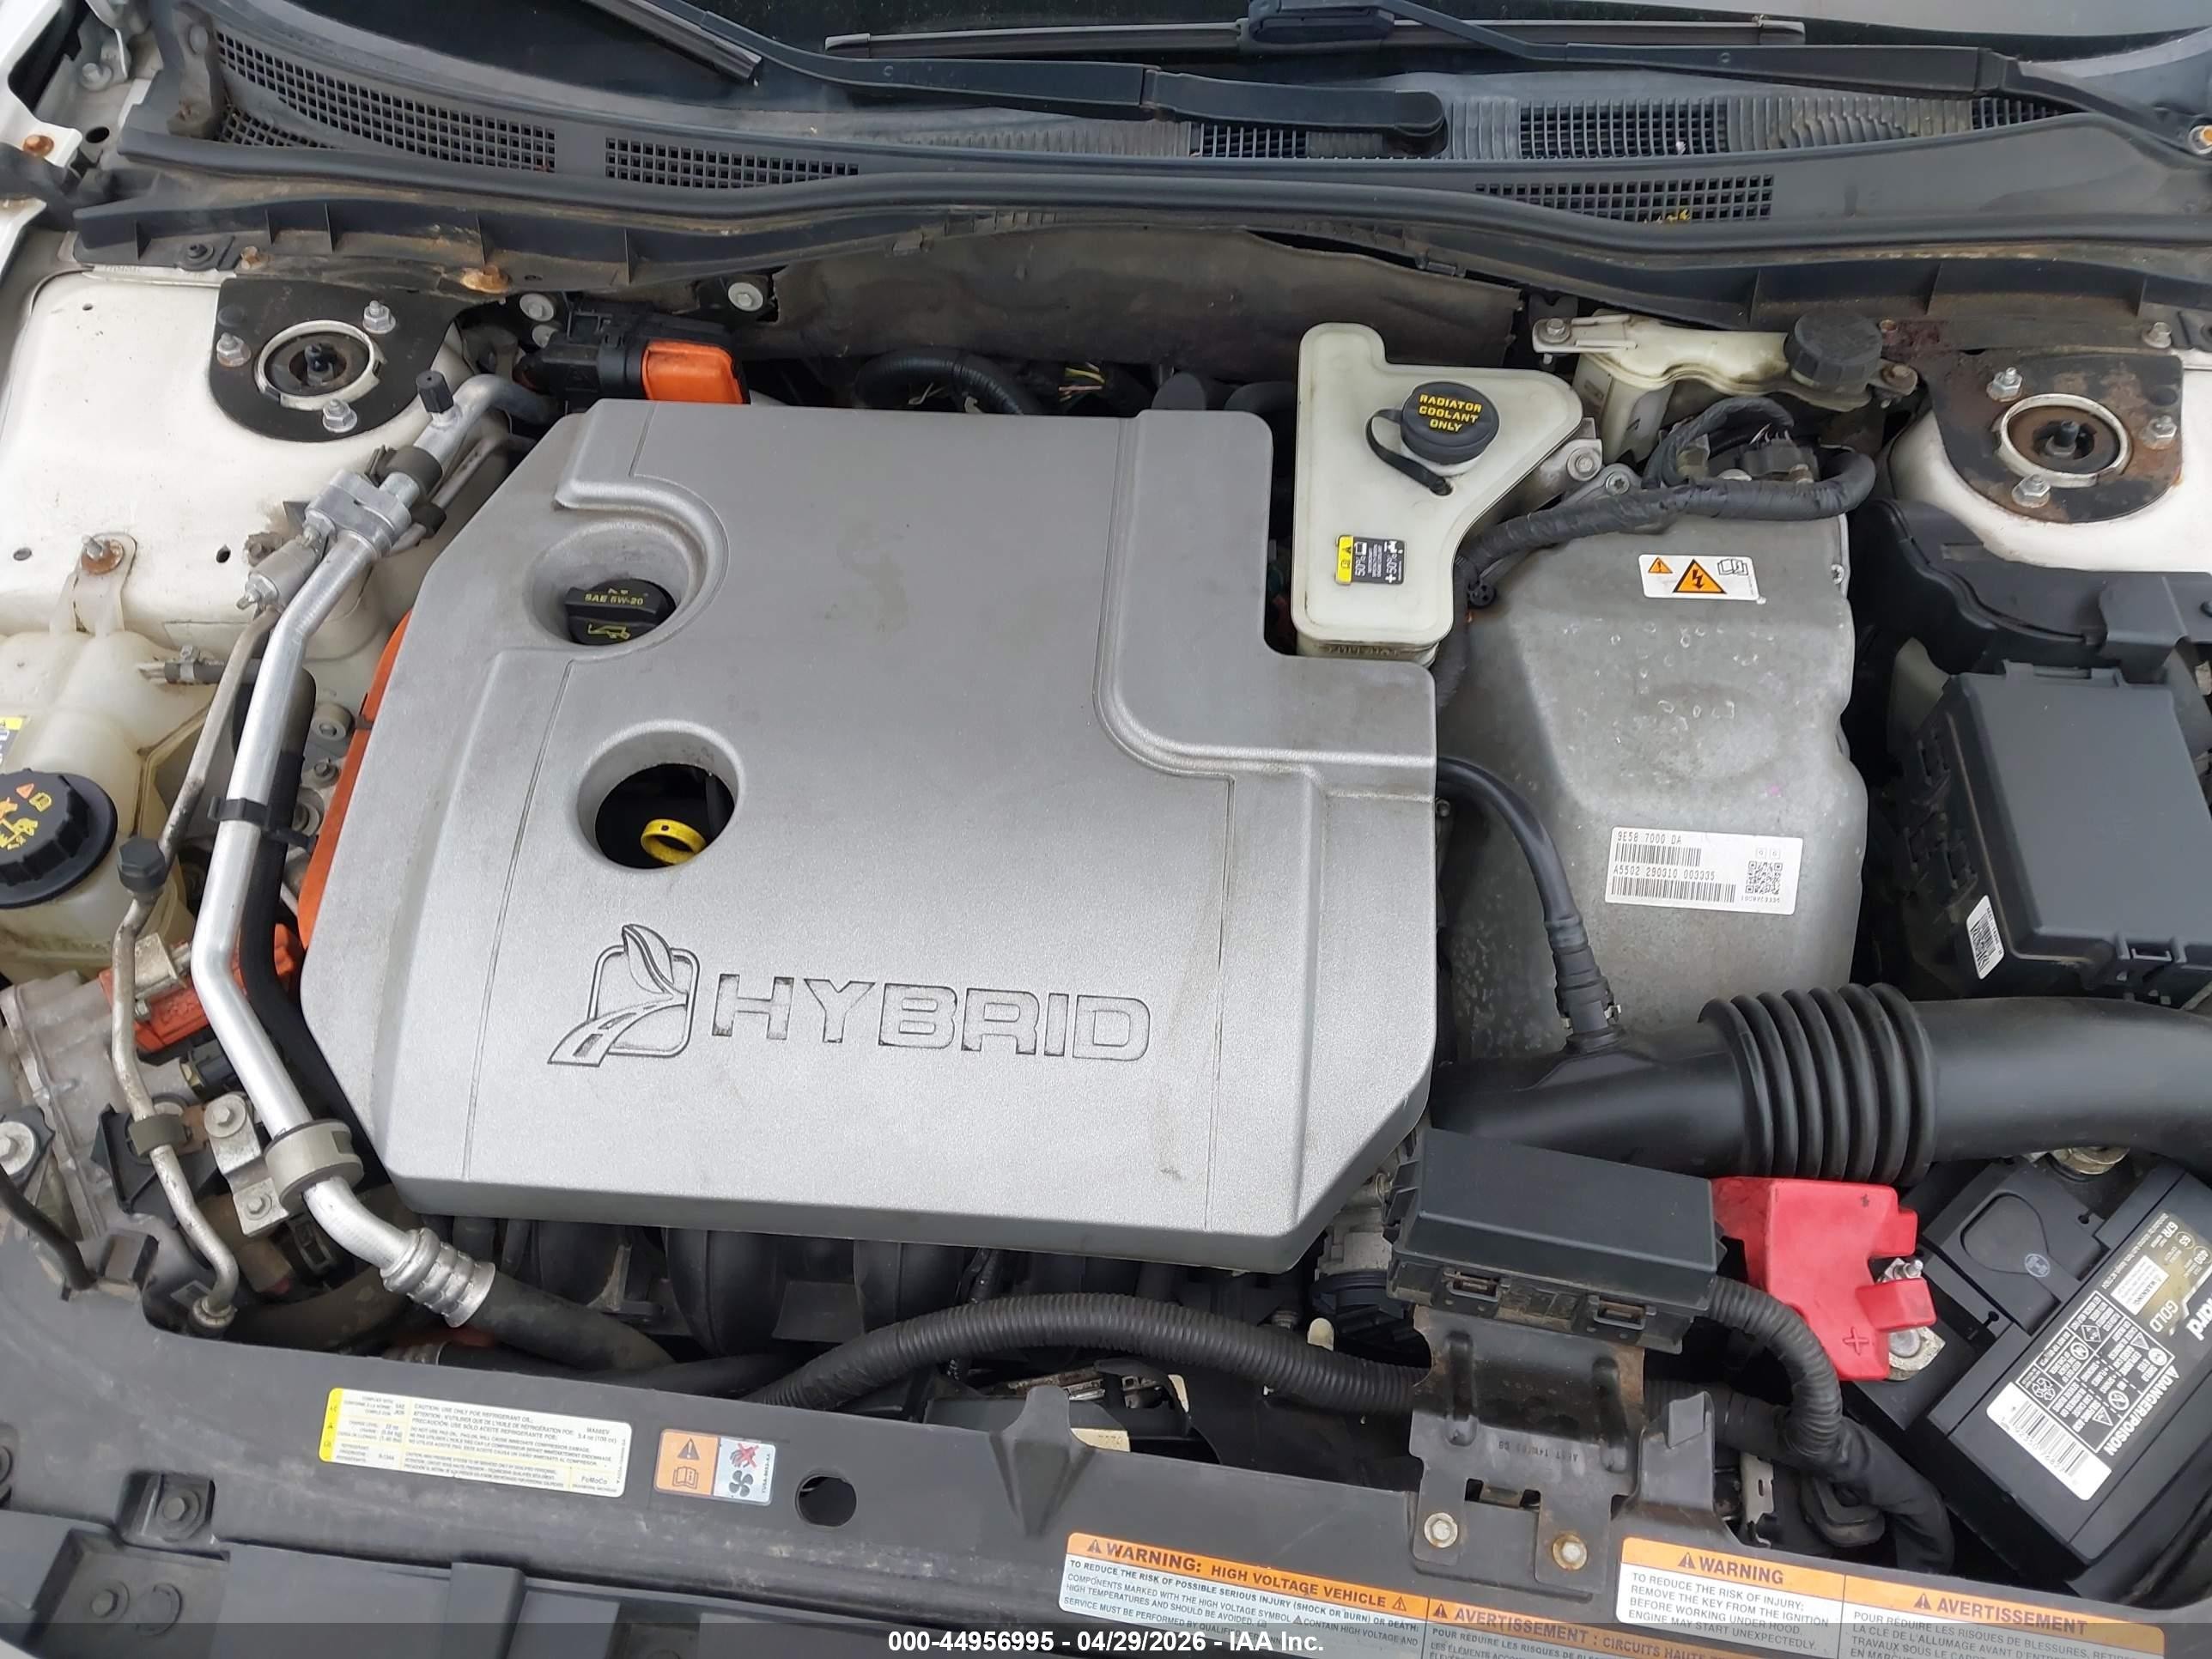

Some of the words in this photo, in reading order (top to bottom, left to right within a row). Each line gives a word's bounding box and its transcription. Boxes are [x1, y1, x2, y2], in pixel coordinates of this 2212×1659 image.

[1419, 394, 1482, 413] RADIATOR
[1419, 405, 1479, 424] COOLANT
[1429, 418, 1462, 433] ONLY
[1355, 555, 1367, 576] 50%
[584, 593, 608, 603] SAE
[610, 595, 644, 605] 5W-20
[1617, 830, 1638, 842] 9E58
[1645, 833, 1666, 844] 7000
[1671, 835, 1681, 845] DA
[1613, 865, 1640, 876] A5502
[711, 972, 1152, 1062] HYBRID
[2160, 1219, 2179, 1239] 67R
[2149, 1299, 2178, 1334] GOLD
[2100, 1371, 2175, 1457] DANGER/POISON
[1107, 1543, 1201, 1572] WARNING:
[1211, 1565, 1248, 1582] HIGH
[1253, 1573, 1319, 1595] VOLTAGE
[1323, 1586, 1387, 1607] VEHICLE
[1699, 1555, 1784, 1585] WARNING
[1070, 1559, 1081, 1568] TO
[1084, 1562, 1118, 1576] REDUCE
[1121, 1569, 1137, 1579] THE
[1139, 1572, 1159, 1583] RISK
[1162, 1577, 1174, 1585] OF
[1176, 1579, 1217, 1594] POSSIBLE
[1219, 1588, 1257, 1601] SERIOUS
[1259, 1595, 1291, 1608] INJURY
[1293, 1601, 1327, 1615] (SHOCK
[1328, 1608, 1341, 1618] OR
[1343, 1611, 1371, 1624] BURN)
[1373, 1617, 1386, 1626] OR
[1633, 1572, 1646, 1583] TO
[1649, 1576, 1692, 1591] REDUCE
[1695, 1583, 1716, 1595] THE
[1719, 1588, 1743, 1600] RISK
[1747, 1593, 1761, 1602] OF
[1064, 1596, 1097, 1610] SERVICE
[1099, 1603, 1121, 1614] MUST
[1122, 1607, 1134, 1617] BE
[1135, 1610, 1185, 1626] PERFORMED
[1187, 1620, 1197, 1629] BY
[1066, 1583, 1085, 1594] HIGH
[1087, 1587, 1150, 1606] TEMPERATURES
[1151, 1599, 1169, 1609] AND
[1170, 1602, 1203, 1615] SHOULD
[1205, 1609, 1215, 1619] BE
[1218, 1612, 1254, 1626] AVOIDED.
[1067, 1573, 1122, 1590] COMPONENTS
[1124, 1583, 1158, 1597] MARKED
[1159, 1590, 1179, 1601] WITH
[1182, 1595, 1196, 1604] THE
[1199, 1598, 1218, 1609] HIGH
[1220, 1602, 1257, 1617] VOLTAGE
[1258, 1609, 1291, 1622] SYMBOL
[1304, 1618, 1339, 1632] CONTAIN
[1340, 1625, 1361, 1637] HIGH
[1362, 1629, 1399, 1643] VOLTAGE
[1401, 1636, 1418, 1646] AND
[1630, 1597, 1673, 1613] BEFORE
[1675, 1605, 1726, 1621] WORKING
[1729, 1614, 1765, 1629] UNDER
[1631, 1584, 1675, 1601] REMOVE
[1679, 1593, 1698, 1605] THE
[1702, 1597, 1723, 1608] KEY
[1725, 1601, 1756, 1614] FROM
[1759, 1607, 1780, 1619] THE
[1783, 1612, 1829, 1627] IGNITION
[1937, 1597, 2088, 1635] AVERTISSEMENT
[1432, 1627, 1457, 1639] POUR
[1460, 1632, 1499, 1647] RÉDUIRE
[1501, 1640, 1518, 1650] LES
[1521, 1644, 1560, 1658] RISQUES
[1455, 1607, 1589, 1644] AVERTISSEMENT
[1602, 1637, 1661, 1657] CIRCUITS
[1628, 1609, 1668, 1624] ENGINE
[1671, 1617, 1692, 1628] MAY
[1696, 1622, 1729, 1634] START
[1732, 1627, 1817, 1650] UNEXPECTEDLY.
[1852, 1624, 1866, 1633] LA
[1893, 1630, 1906, 1640] DE
[1909, 1632, 1976, 1651] L'ALLUMAGE
[1979, 1644, 2012, 1656] AVANT
[1854, 1611, 1883, 1624] POUR
[1887, 1616, 1932, 1632] RÉDUIRE
[1936, 1626, 1954, 1636] LES
[1958, 1628, 2004, 1644] RISQUES
[2006, 1637, 2021, 1646] DE
[1431, 1642, 1446, 1651] LES
[1850, 1648, 1864, 1658] EN
[1852, 1636, 1899, 1651] TRAVAUX
[1902, 1644, 1931, 1656] SOUS
[1935, 1650, 1947, 1659] LE
